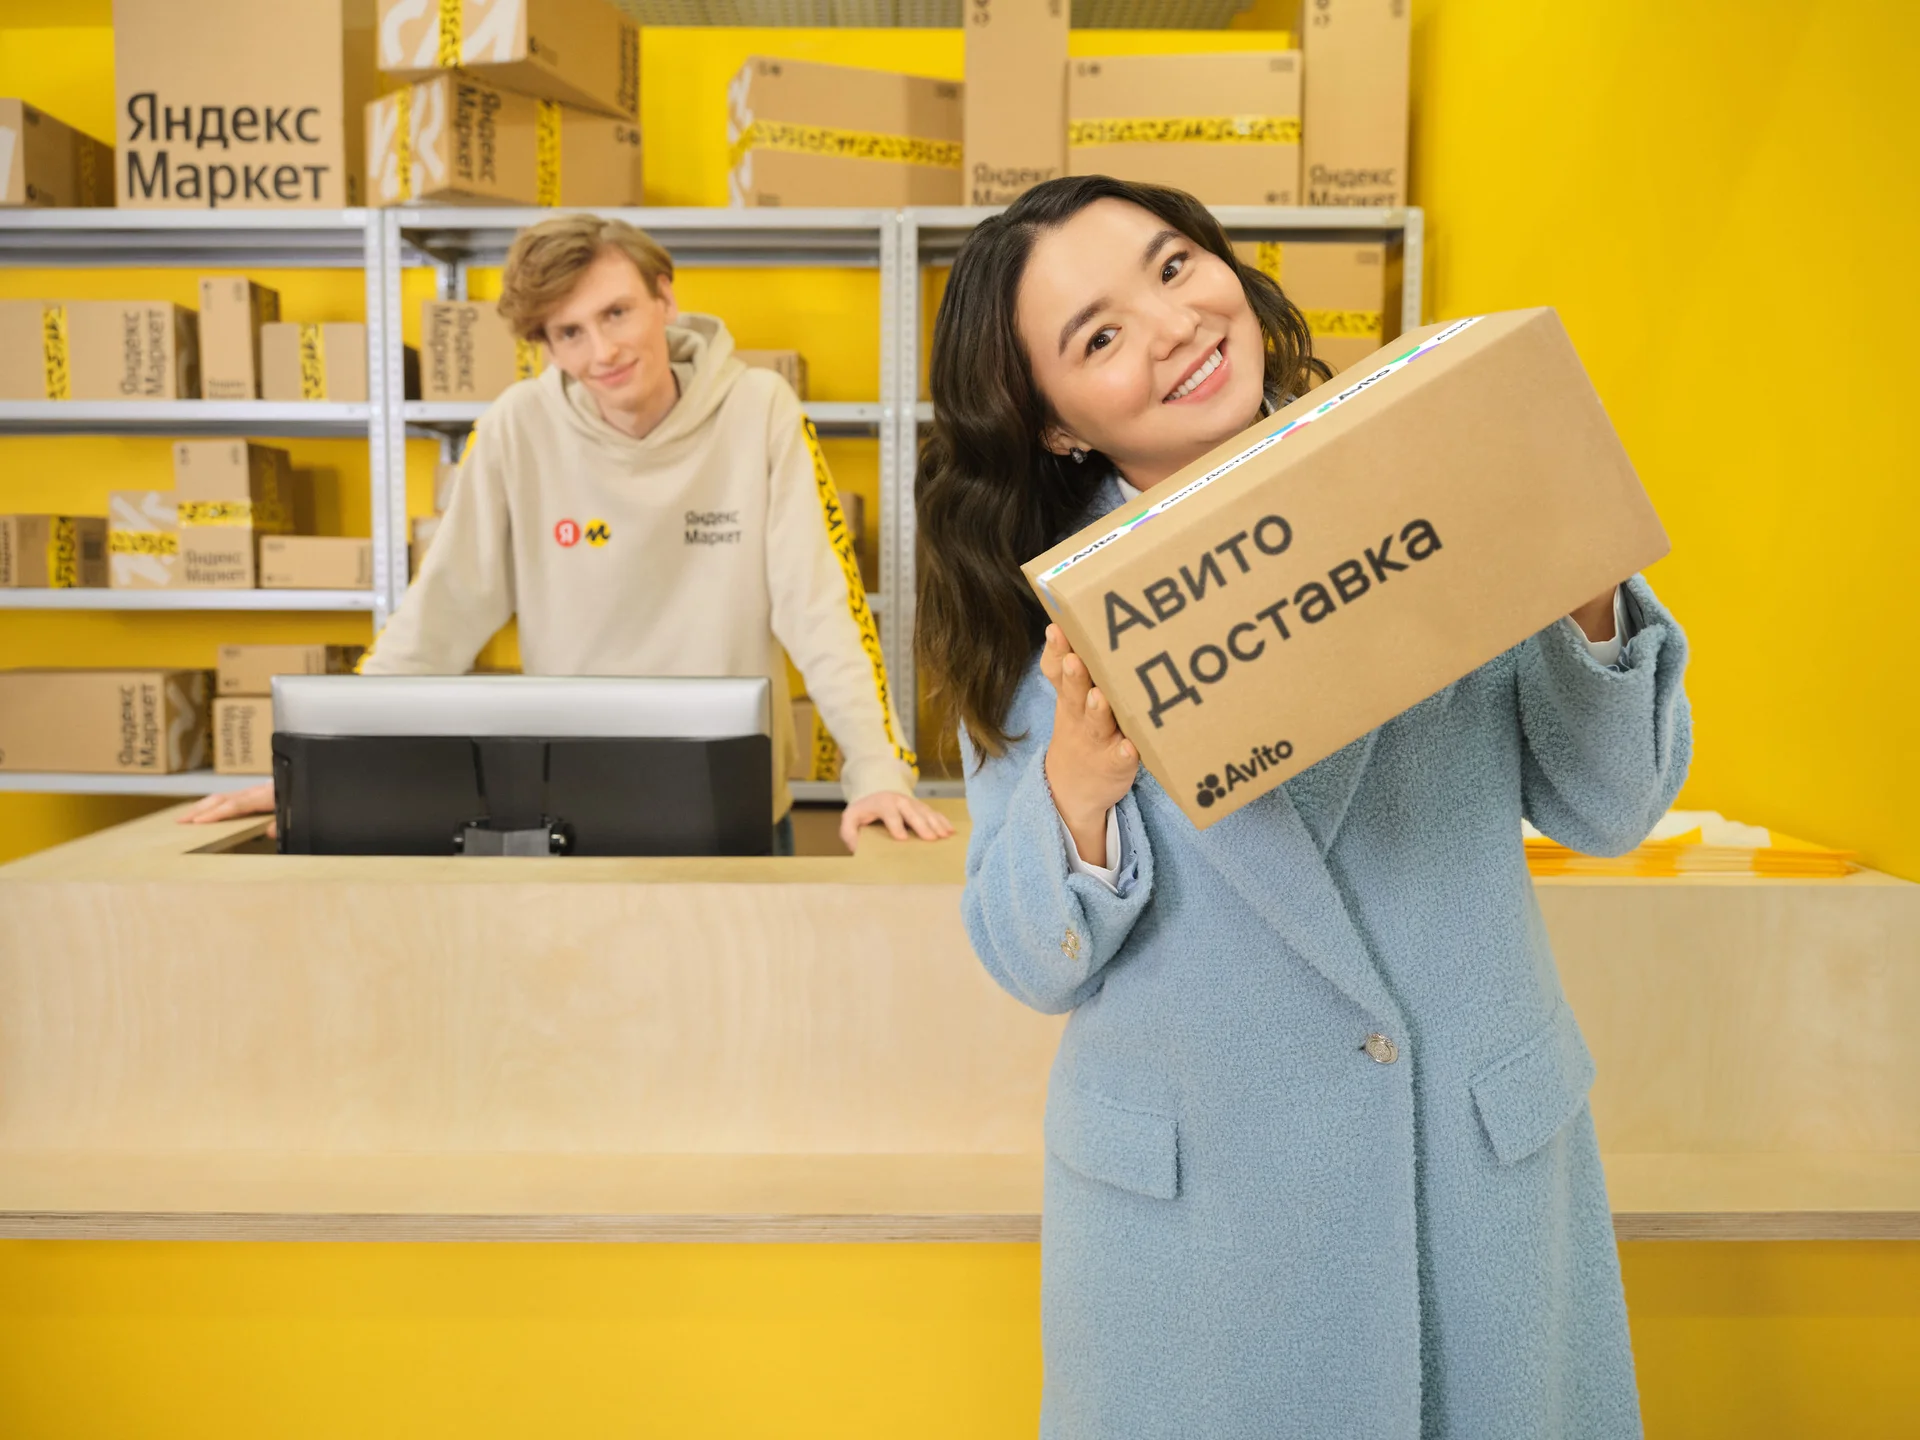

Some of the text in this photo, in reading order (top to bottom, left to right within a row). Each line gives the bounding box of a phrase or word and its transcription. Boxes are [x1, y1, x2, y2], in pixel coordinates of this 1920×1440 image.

[127, 92, 321, 149] Яндекс
[454, 84, 478, 182] Маркет
[477, 91, 500, 184] Яндекс
[127, 151, 330, 208] Маркет
[1310, 164, 1396, 188] Яндекс
[1339, 369, 1390, 401] Avito
[1160, 438, 1275, 508] Авито Доставка
[684, 529, 742, 546] Маркет
[685, 511, 740, 526] Яндекс
[1072, 533, 1118, 562] Avito
[1103, 515, 1293, 652] Авито
[1135, 518, 1443, 729] Доставка
[118, 685, 138, 766] Яндекс
[140, 683, 159, 767] Маркет
[1224, 740, 1294, 792] Avito
